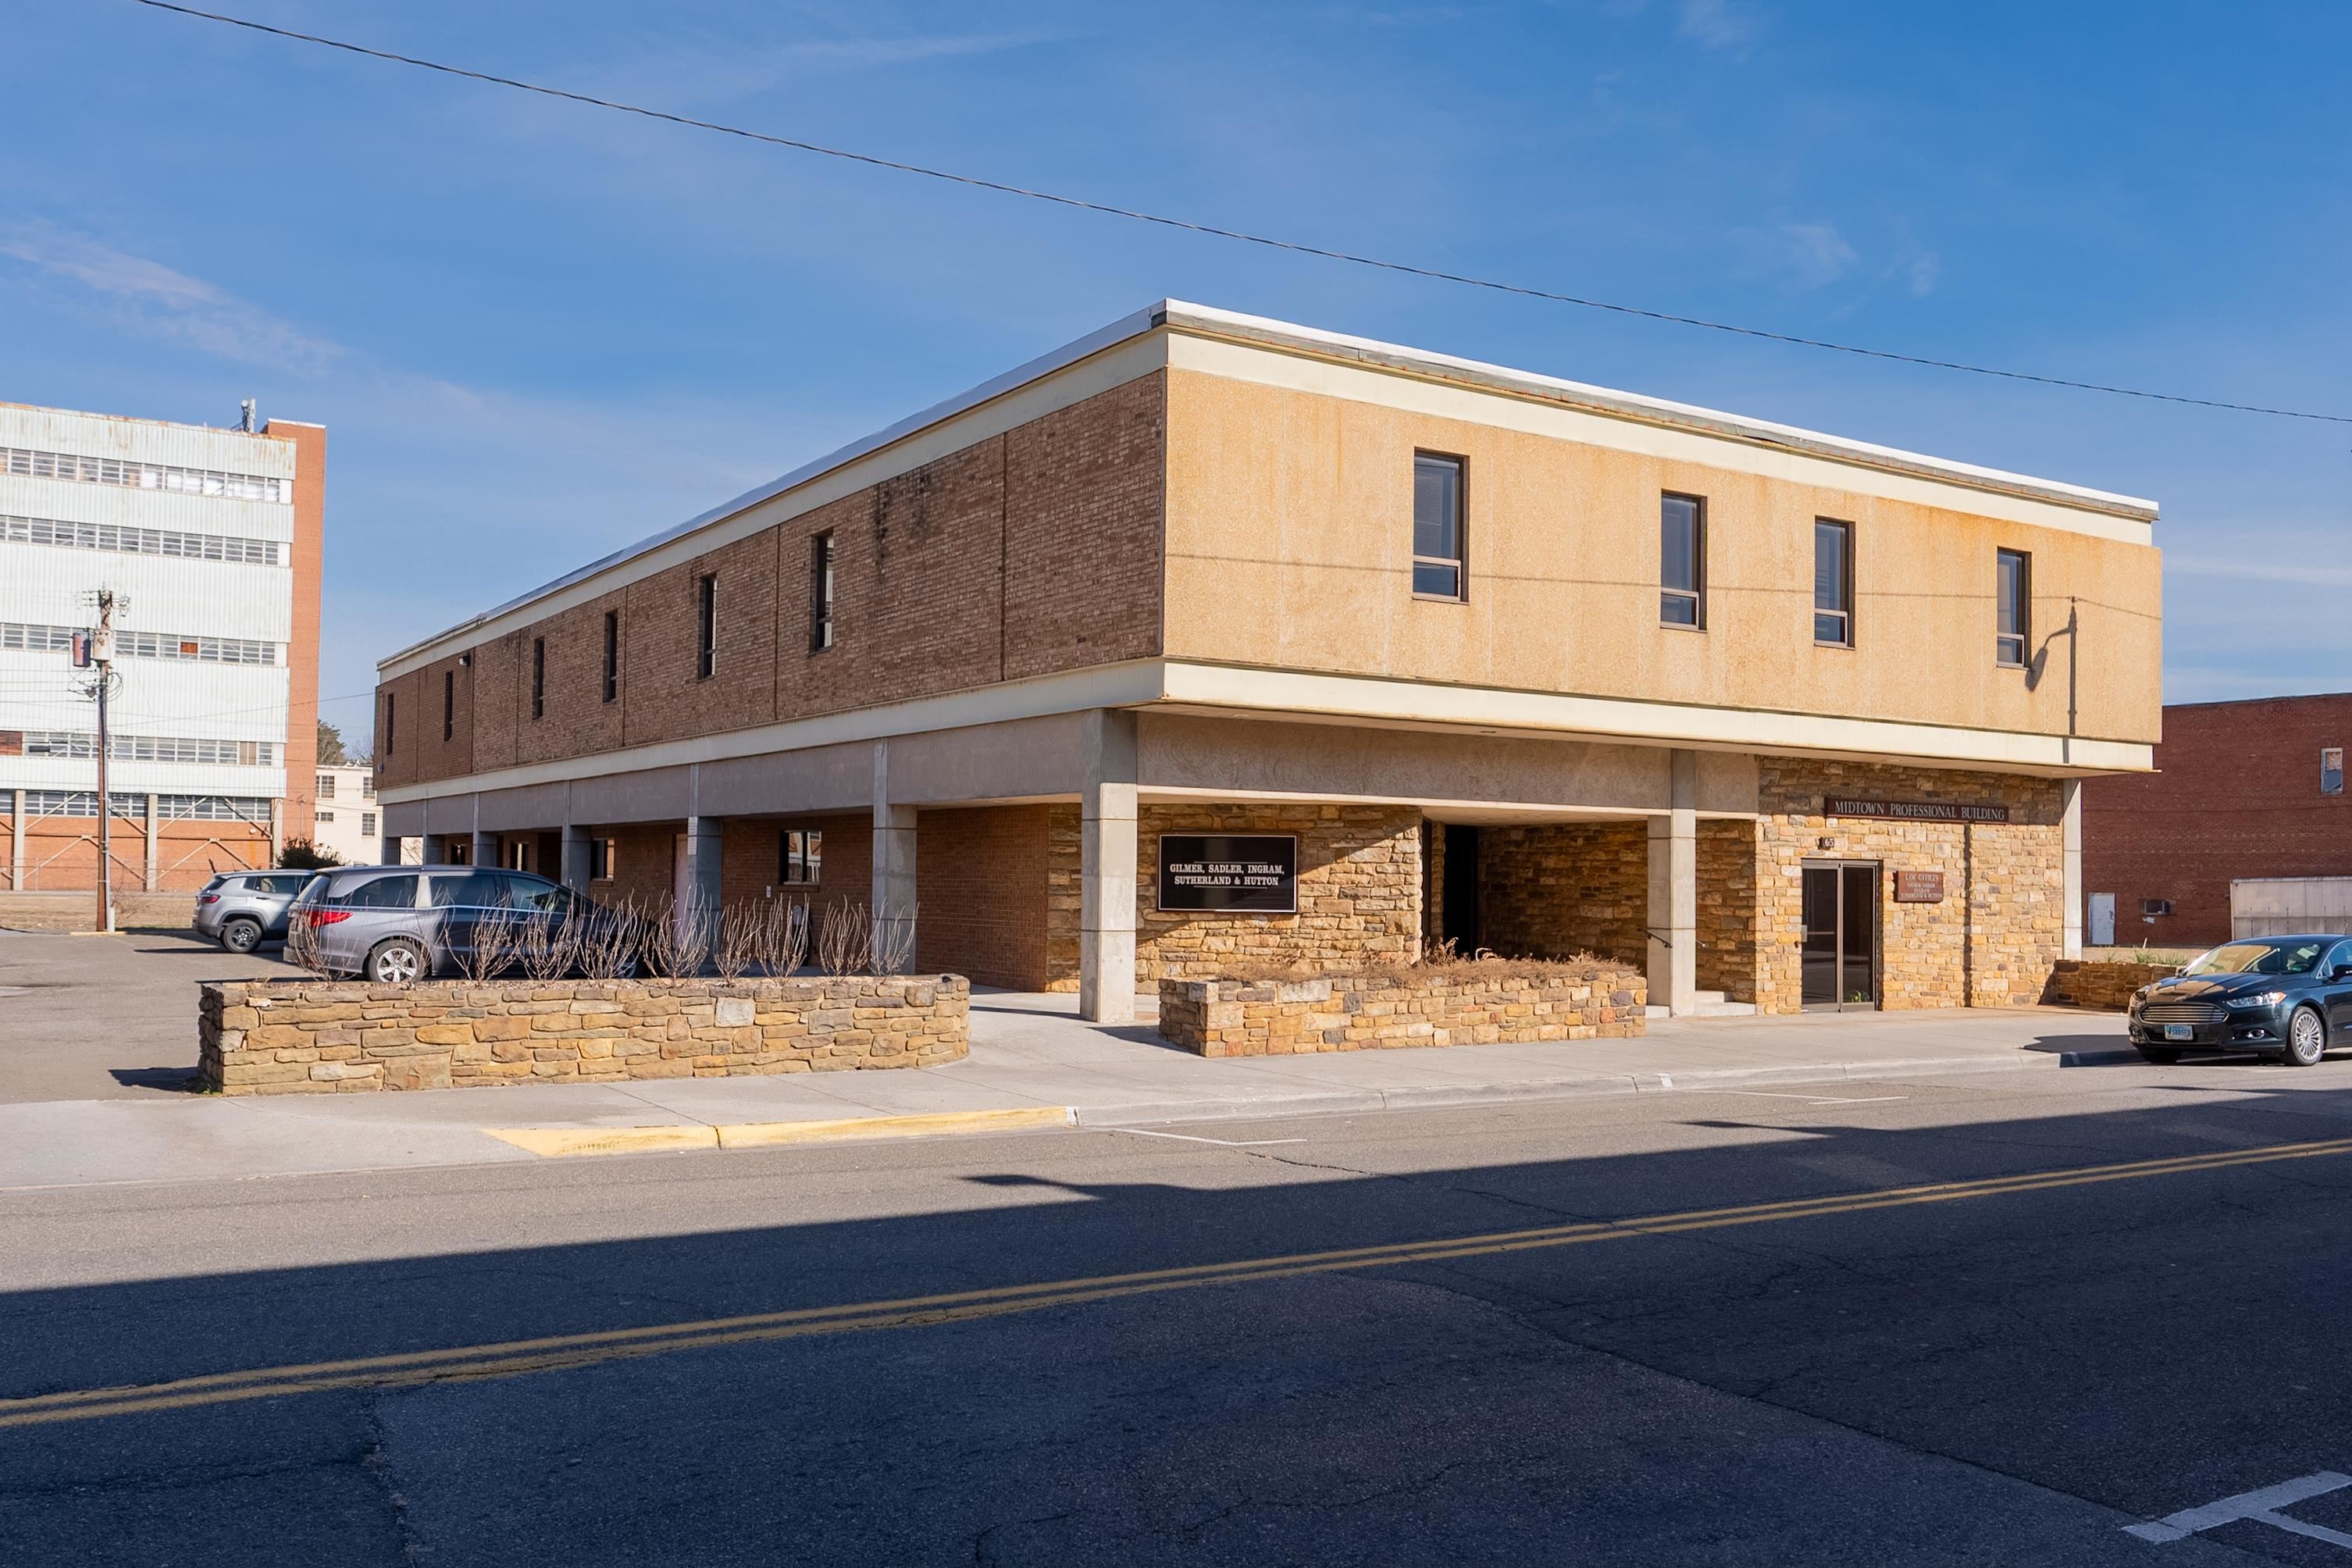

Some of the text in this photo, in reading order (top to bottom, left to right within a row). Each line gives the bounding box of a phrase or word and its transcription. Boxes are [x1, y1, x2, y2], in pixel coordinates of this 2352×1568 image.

[1835, 801, 2005, 820] MIDTOWN PROFESSIONAL BUILDING
[1825, 838, 1833, 846] 65
[1170, 864, 1285, 875] GILMER, SADLER, INGRAM,
[1174, 875, 1279, 886] SUTHERLAND & HUTTON
